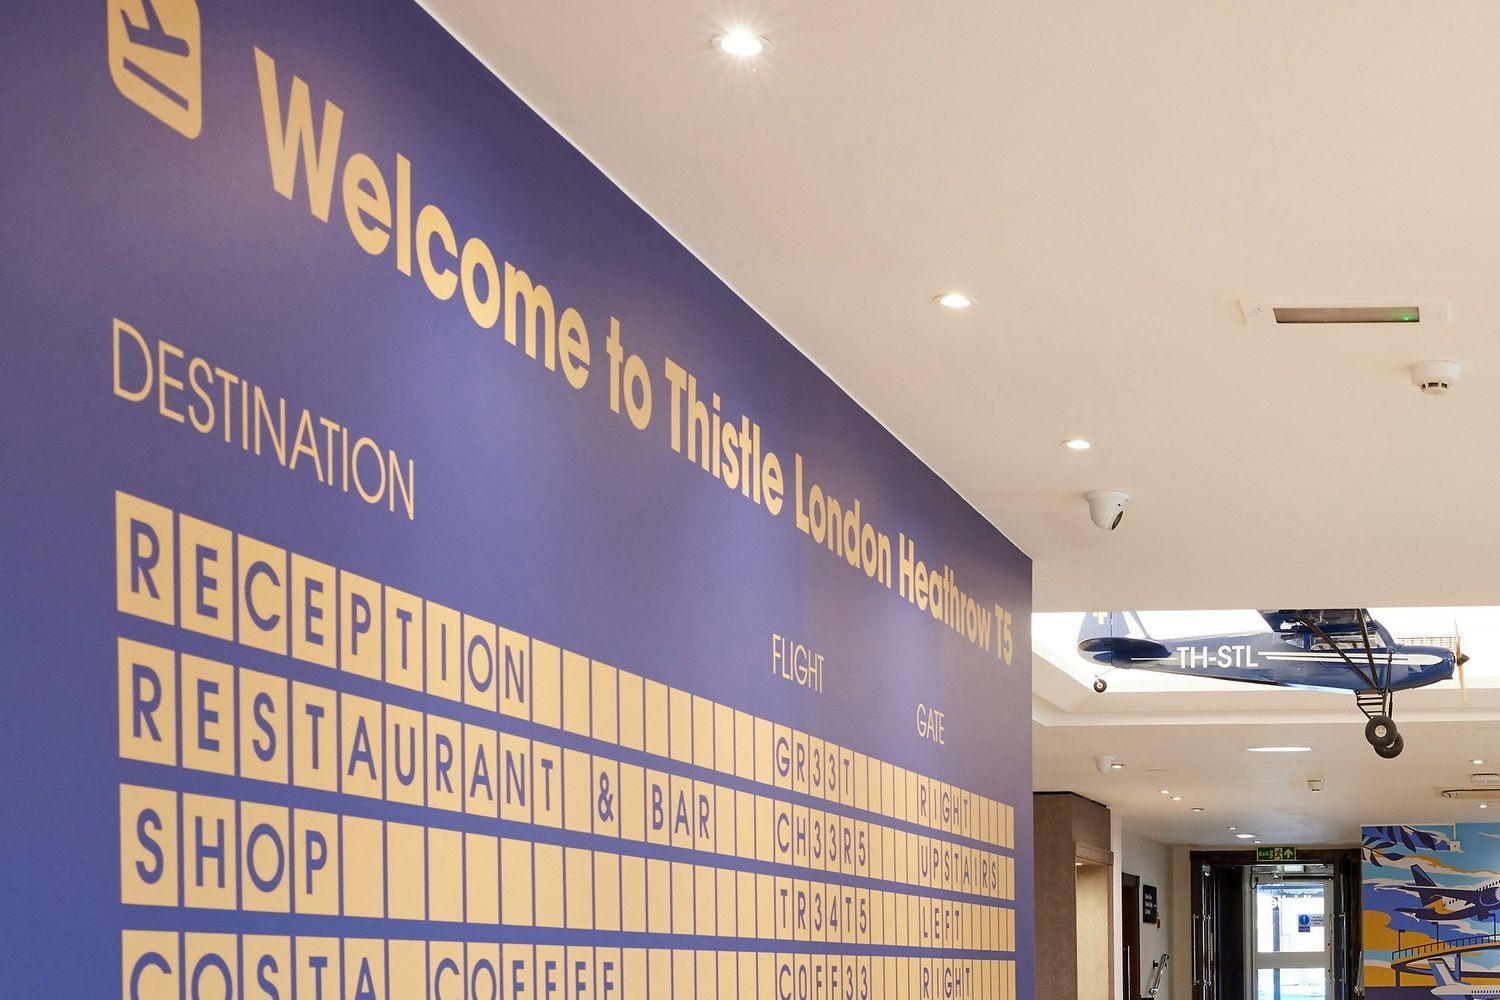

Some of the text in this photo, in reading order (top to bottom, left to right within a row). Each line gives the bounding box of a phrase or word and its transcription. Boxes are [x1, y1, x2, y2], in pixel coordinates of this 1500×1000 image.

[253, 48, 1013, 666] Welcome to Thistle London Heathrow T5
[112, 319, 944, 745] DESTINATION FLIGHT GATE
[130, 518, 968, 829] RECEPTION GR33T RIGHT
[1176, 645, 1259, 669] TH-STL
[131, 662, 997, 890] RESTAURANT & BAR CH33R5 UPSTAIRS
[135, 807, 960, 942] SHOP TR34T5 LEFT
[923, 967, 970, 999] RIGHT
